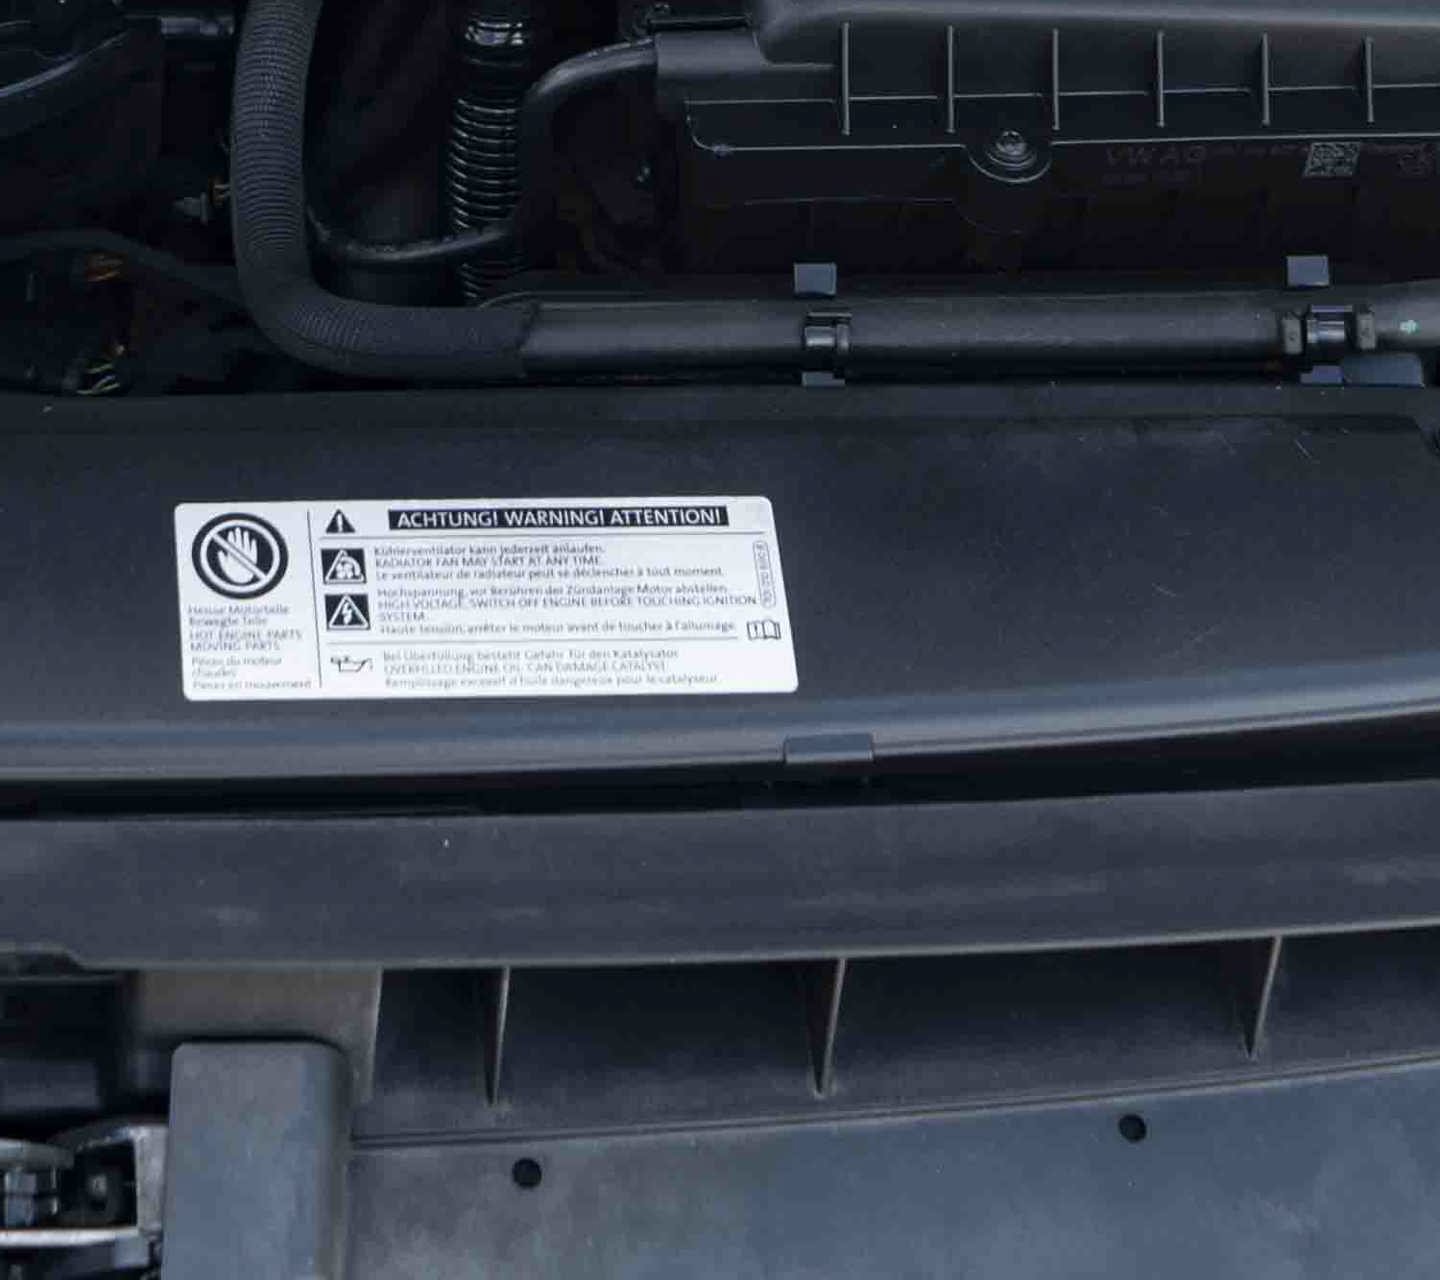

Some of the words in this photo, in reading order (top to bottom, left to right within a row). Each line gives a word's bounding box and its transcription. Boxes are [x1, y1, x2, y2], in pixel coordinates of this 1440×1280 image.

[398, 511, 498, 528] ACHTUNG!
[504, 510, 604, 526] WARNING!
[611, 509, 721, 525] ATTENTION!
[375, 557, 432, 568] RADIATOR
[436, 557, 459, 566] FAN
[462, 557, 487, 566] MAY
[492, 556, 525, 566] START
[529, 557, 544, 566] AT
[546, 556, 569, 565] ANY
